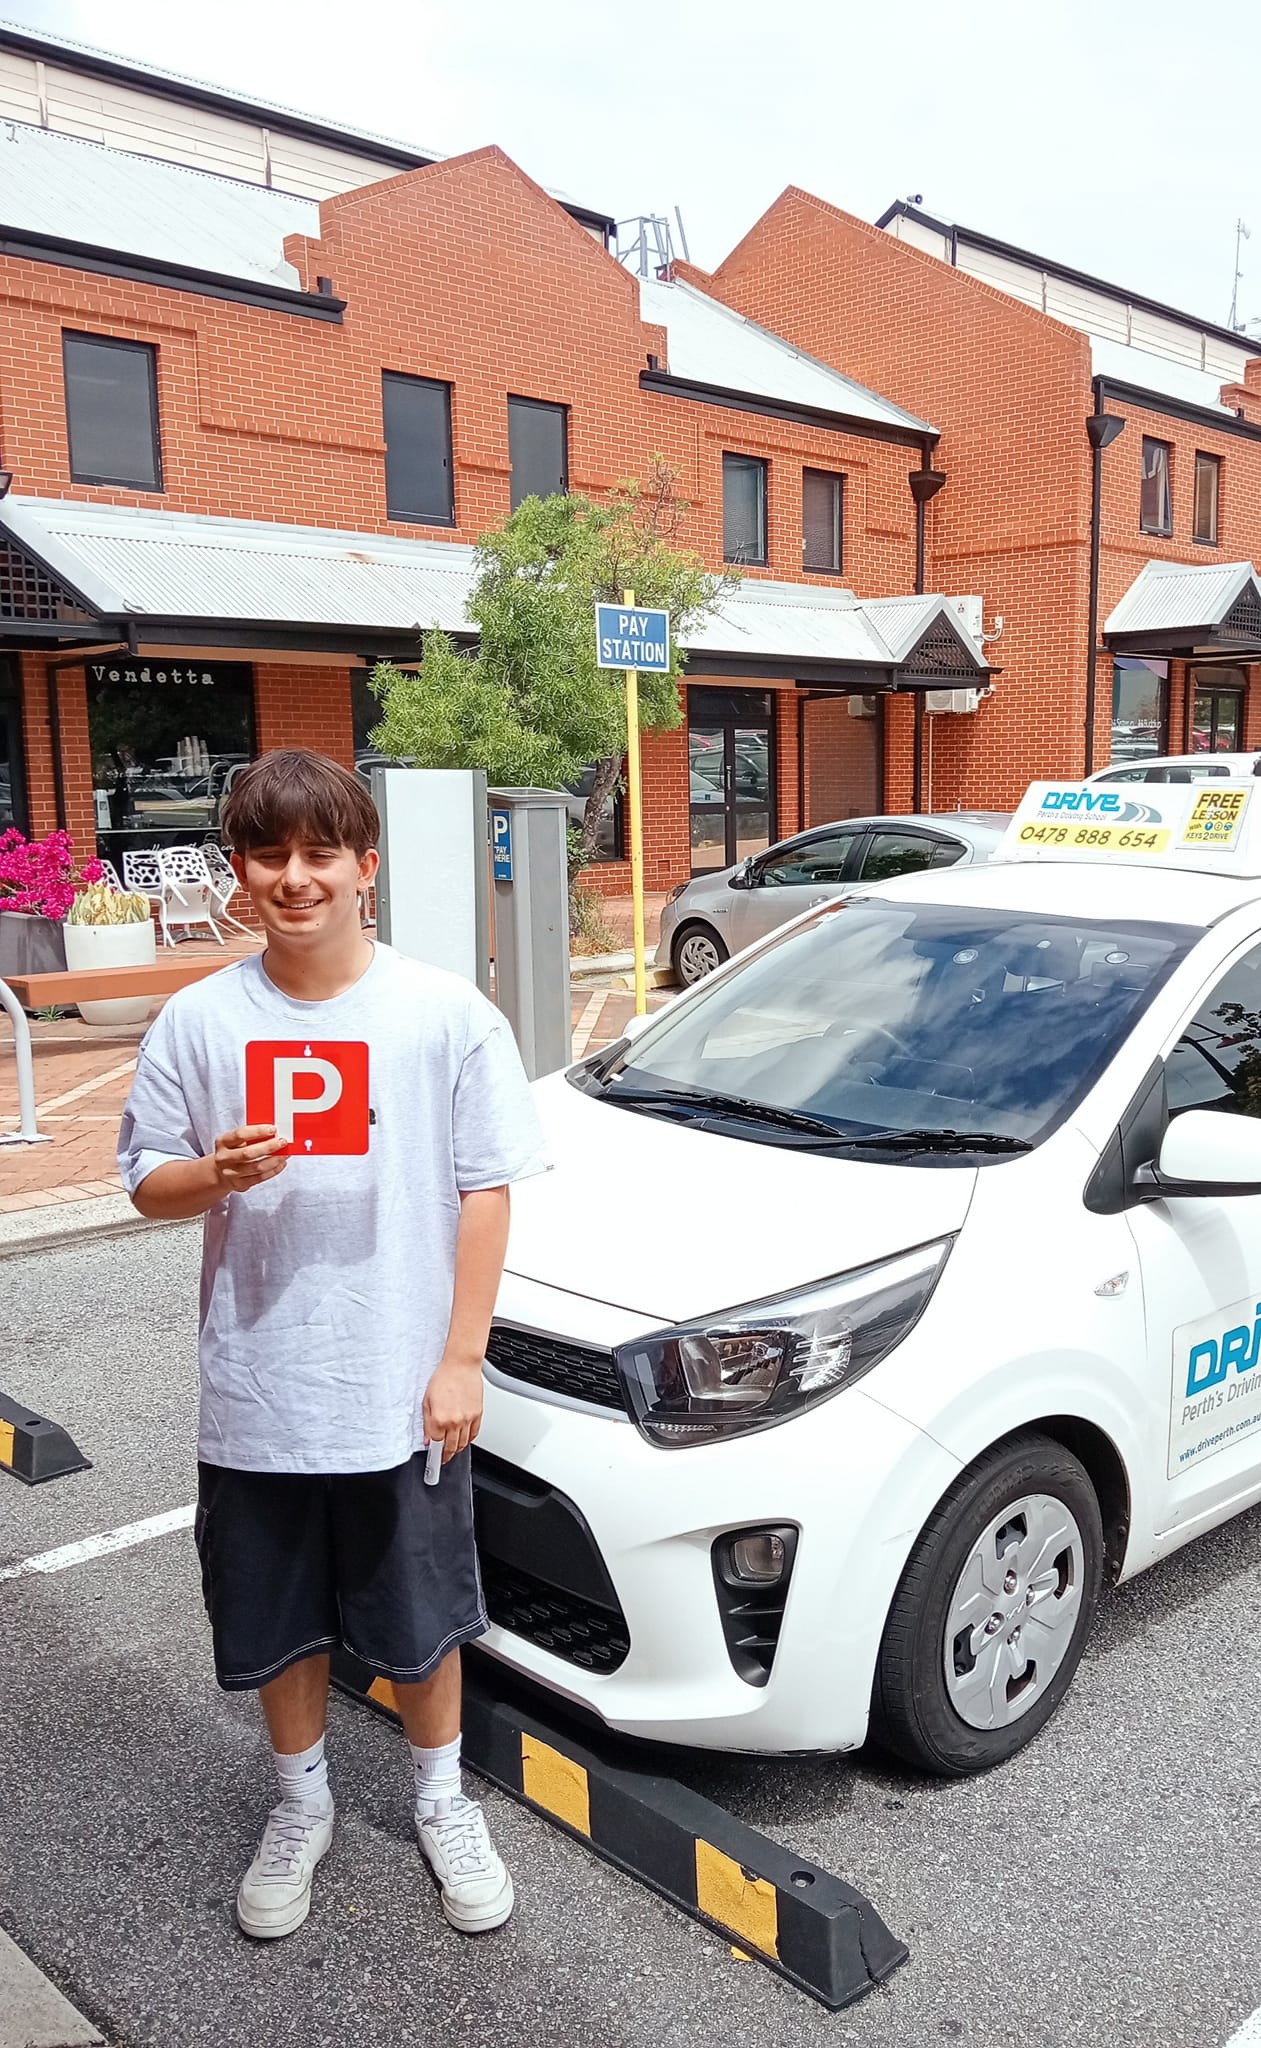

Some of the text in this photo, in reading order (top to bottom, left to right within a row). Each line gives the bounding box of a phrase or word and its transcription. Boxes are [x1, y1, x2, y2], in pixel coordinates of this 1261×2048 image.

[619, 614, 648, 637] PAY
[602, 638, 664, 663] STATION
[91, 665, 215, 685] Vendetta
[1197, 793, 1244, 809] FREE
[1084, 812, 1108, 821] School
[494, 815, 508, 843] P
[1020, 826, 1158, 848] 0478 888 654
[494, 846, 507, 854] PAY
[495, 855, 511, 863] HERE
[273, 1057, 343, 1144] P
[1181, 1390, 1225, 1426] Perth's
[1179, 1411, 1261, 1463] www.driveperth.com.au
